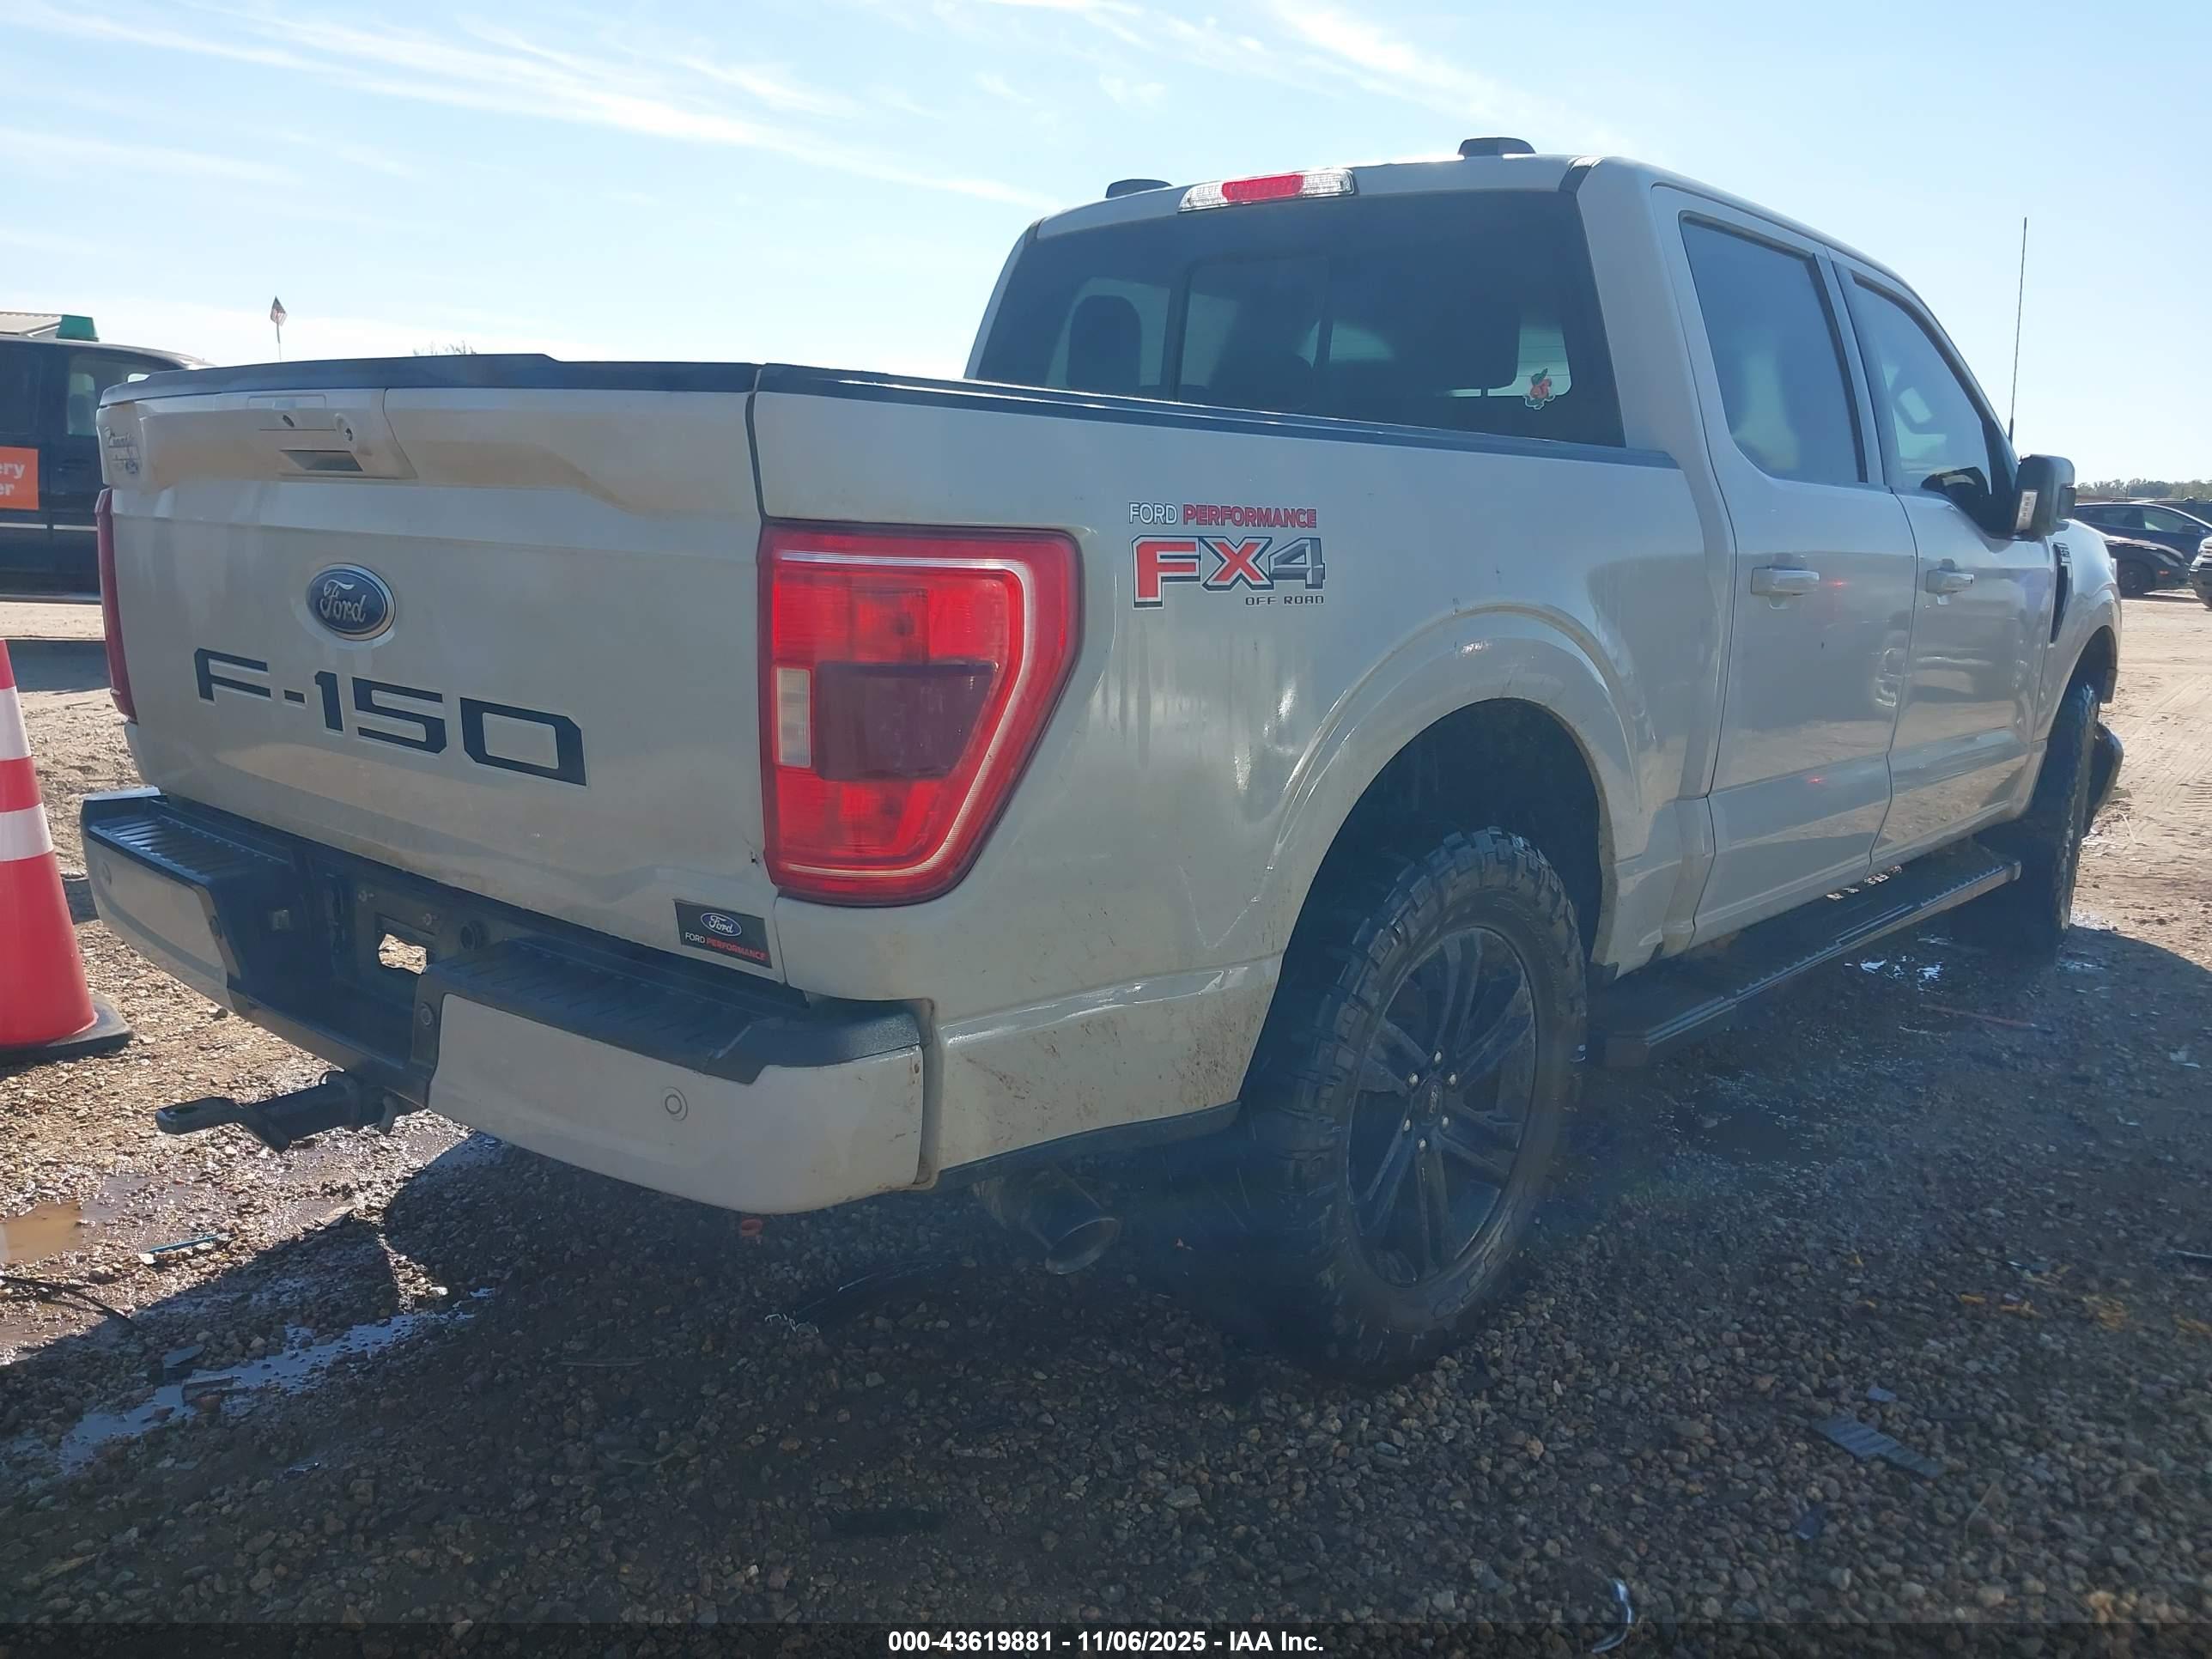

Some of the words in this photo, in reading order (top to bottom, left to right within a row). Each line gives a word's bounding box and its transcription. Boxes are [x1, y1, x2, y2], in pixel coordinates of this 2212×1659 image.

[1128, 502, 1177, 525] FORD
[1182, 504, 1317, 528] PERFORMANCE
[1131, 534, 1326, 609] FX4
[319, 579, 367, 623] Ford
[1245, 597, 1276, 605] OFF
[1284, 595, 1324, 605] ROAD
[193, 647, 587, 786] F-150
[708, 915, 734, 933] Ford
[685, 932, 706, 944] FORD
[706, 938, 766, 961] PERFORMANCE
